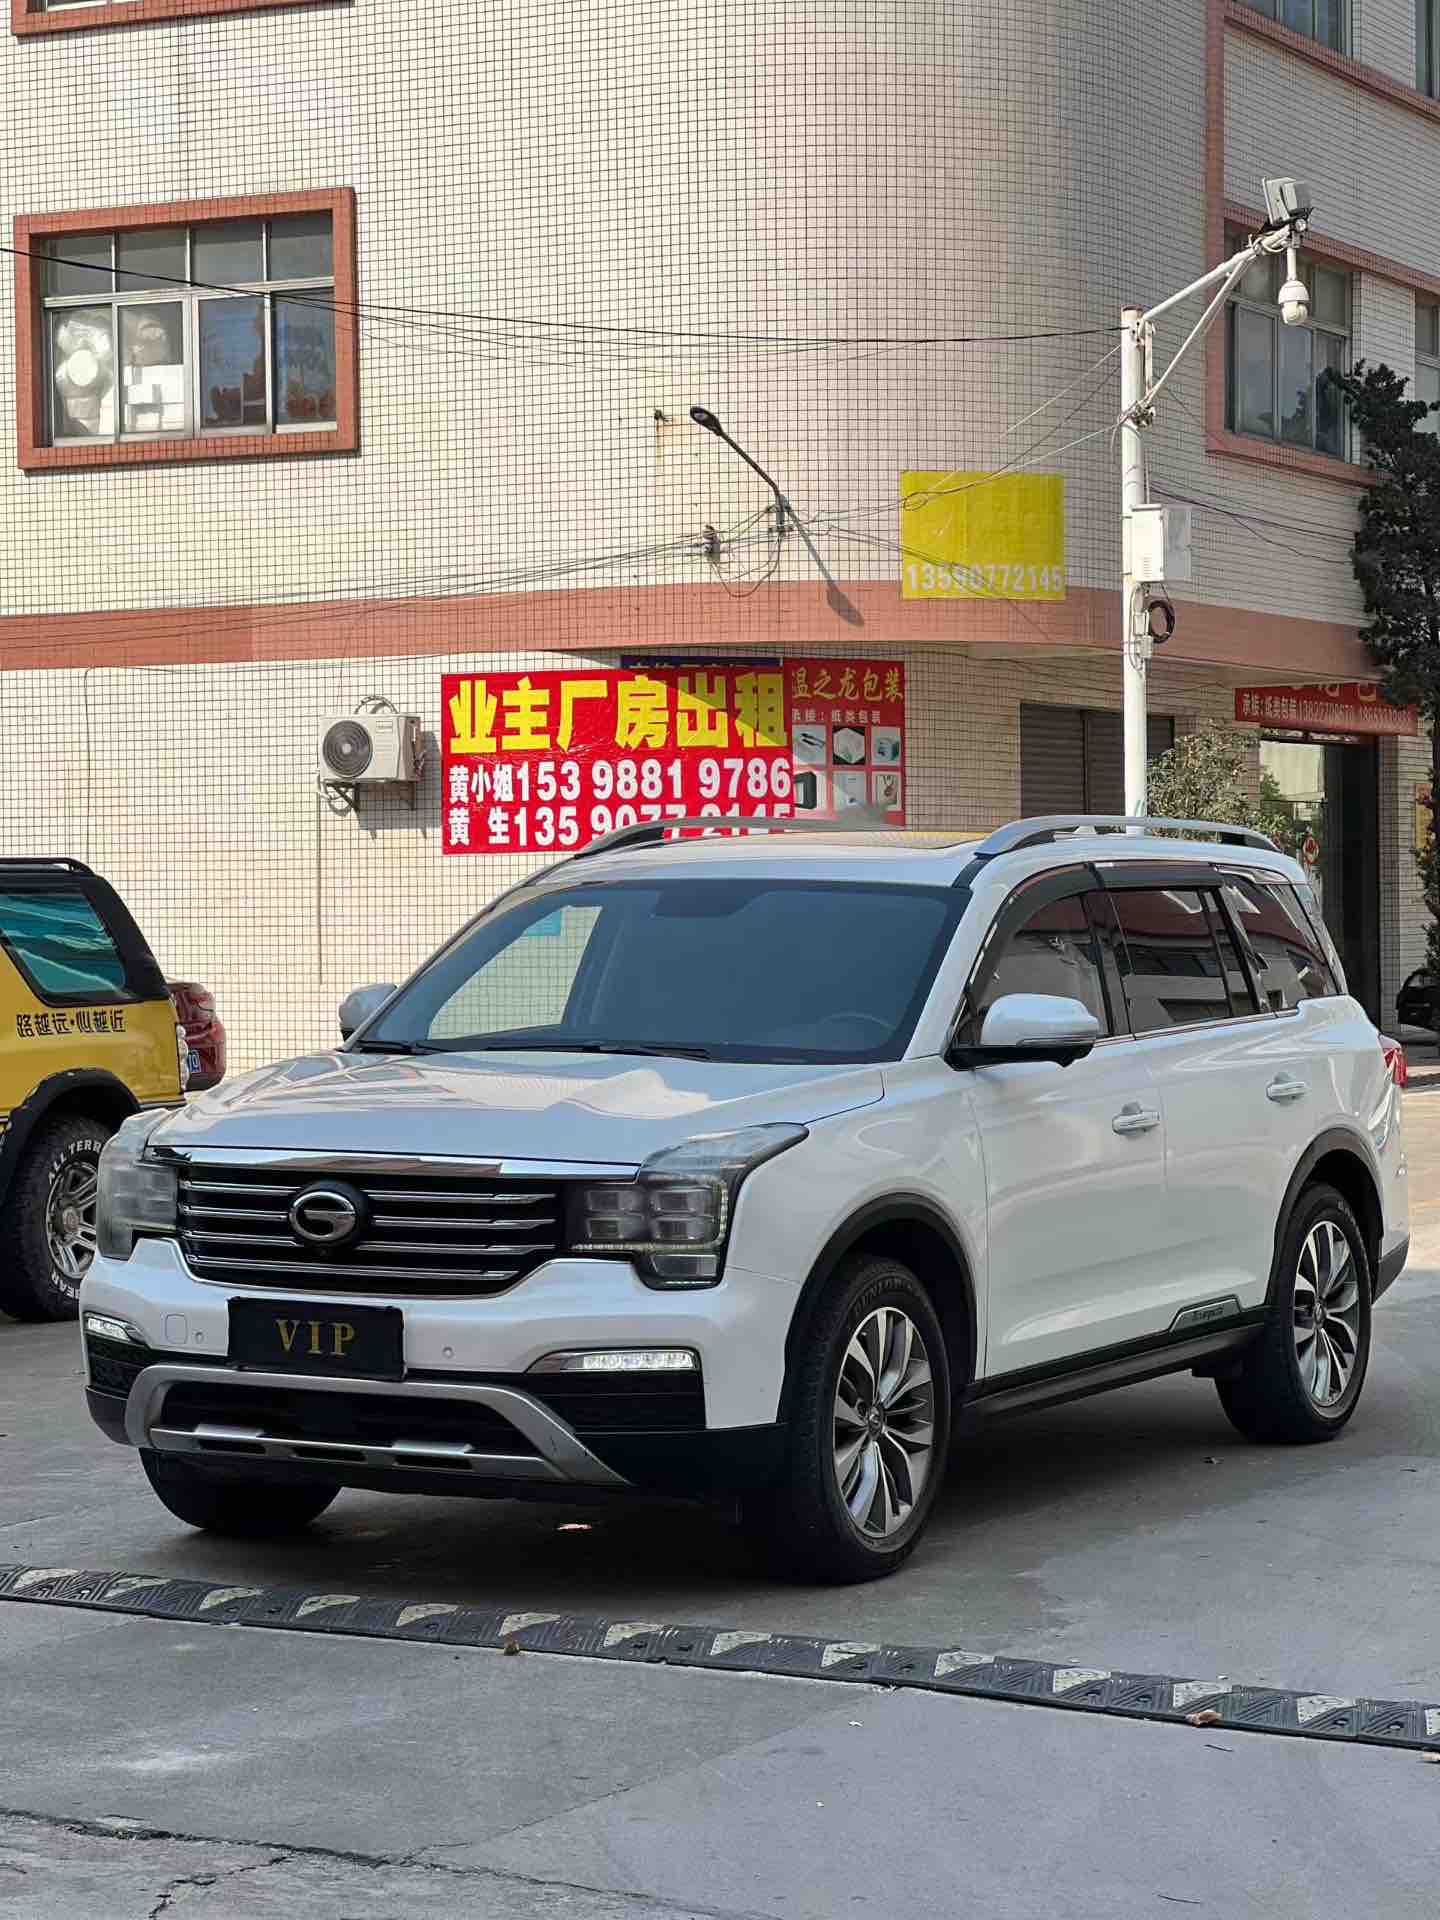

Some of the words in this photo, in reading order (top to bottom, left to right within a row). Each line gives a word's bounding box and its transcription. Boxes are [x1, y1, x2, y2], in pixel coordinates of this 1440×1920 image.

[449, 673, 787, 753] 业主厂房出租
[592, 758, 683, 800] 9881
[699, 757, 791, 799] 9786
[48, 1152, 67, 1185] ALL
[275, 1318, 356, 1357] VIP
